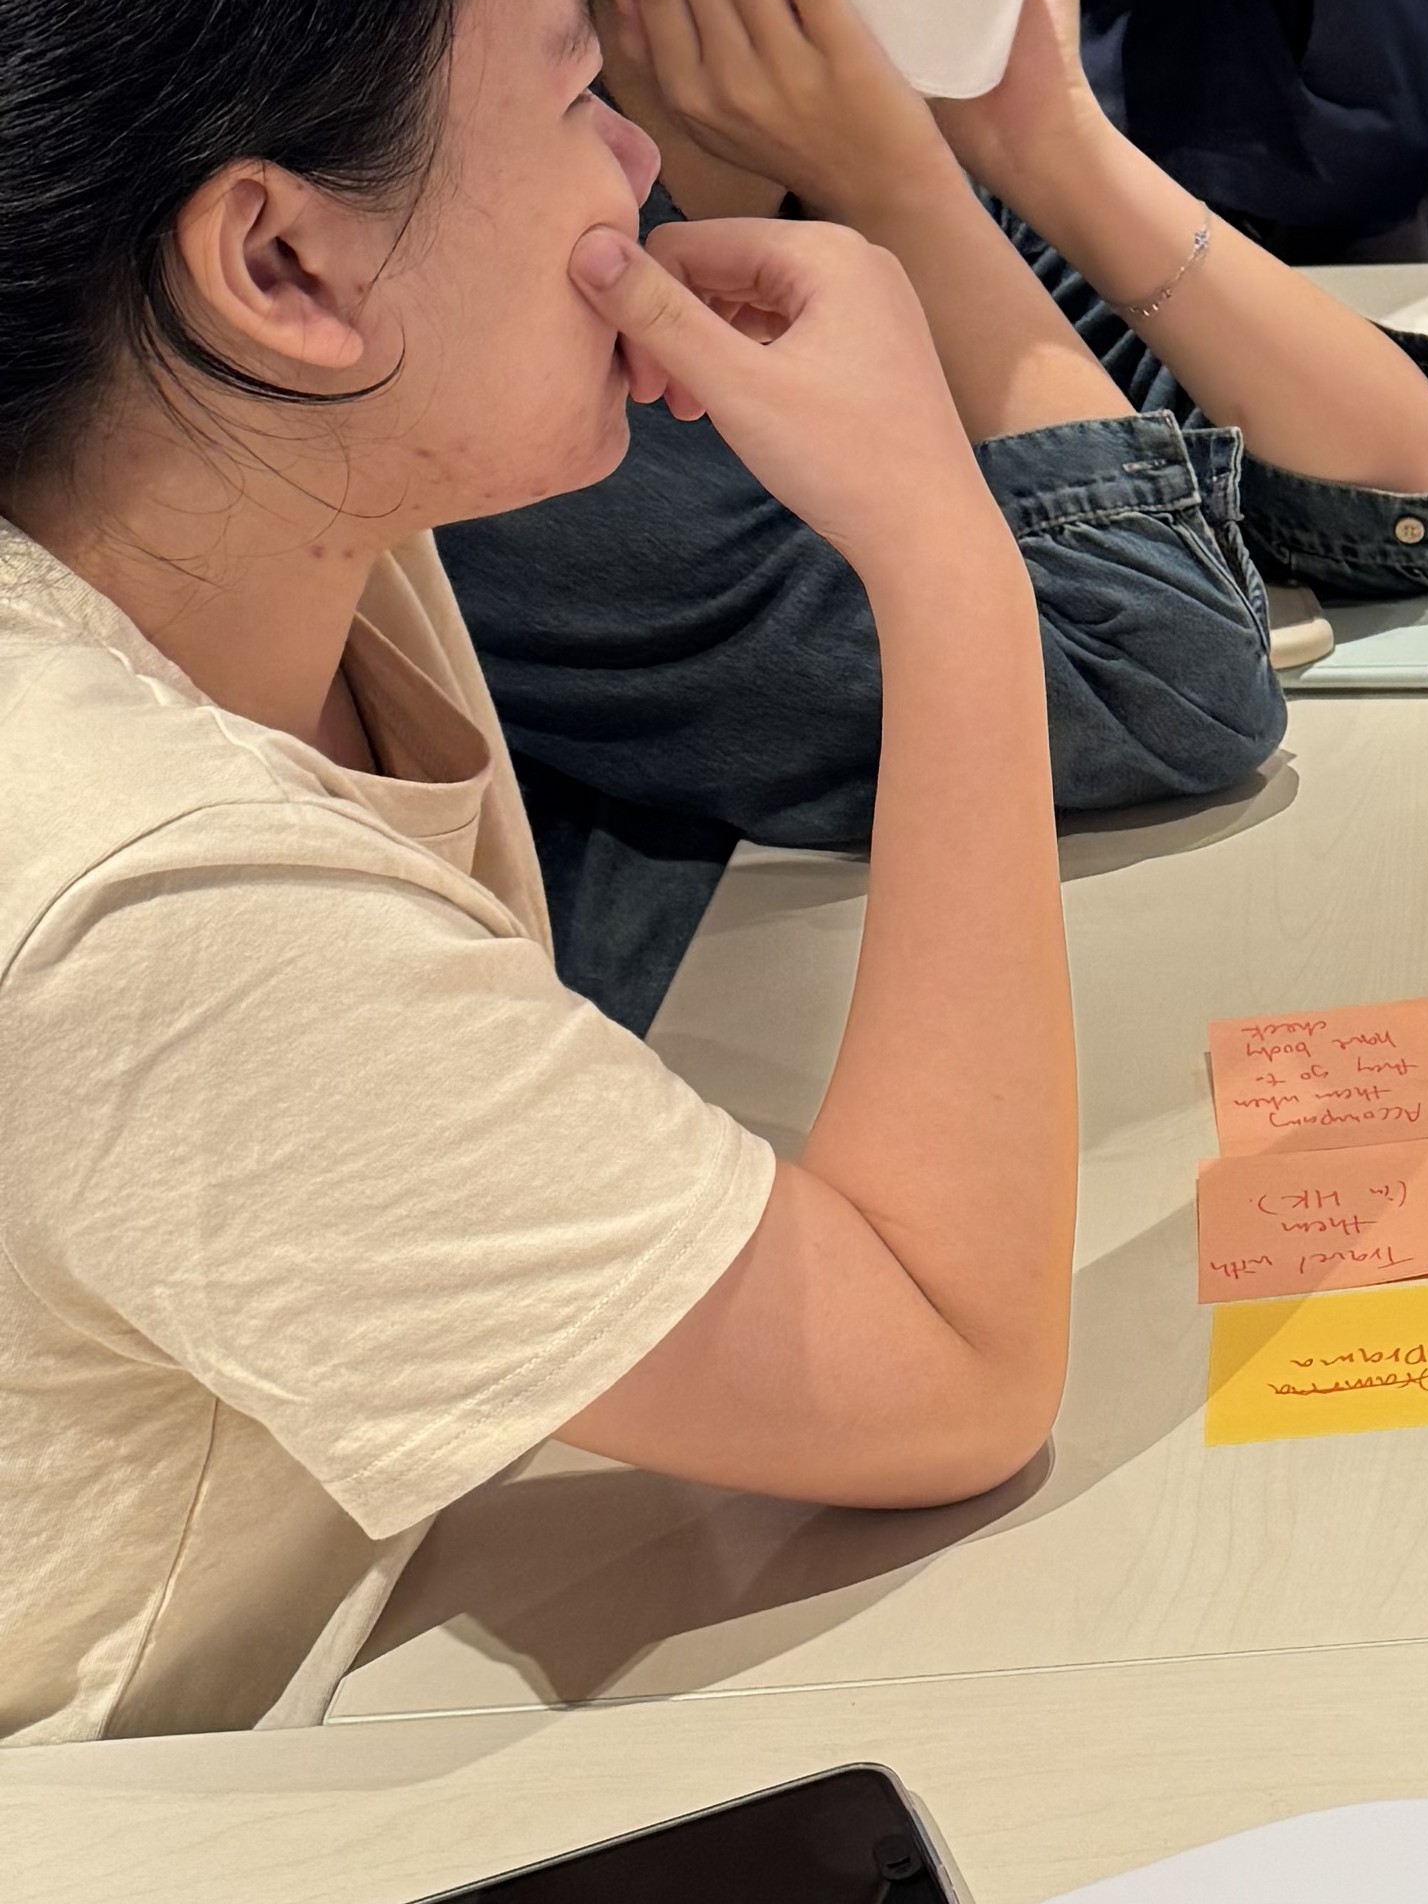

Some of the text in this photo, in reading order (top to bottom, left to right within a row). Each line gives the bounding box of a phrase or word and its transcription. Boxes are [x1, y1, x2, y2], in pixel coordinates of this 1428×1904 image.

[1241, 1018, 1328, 1040] check
[1244, 1040, 1311, 1062] body
[1300, 1065, 1330, 1083] go
[1357, 1057, 1419, 1076] they
[1232, 1083, 1391, 1110] them when
[1281, 1212, 1378, 1236] them
[1209, 1245, 1414, 1281] Travel with
[1289, 1343, 1427, 1368] Drama
